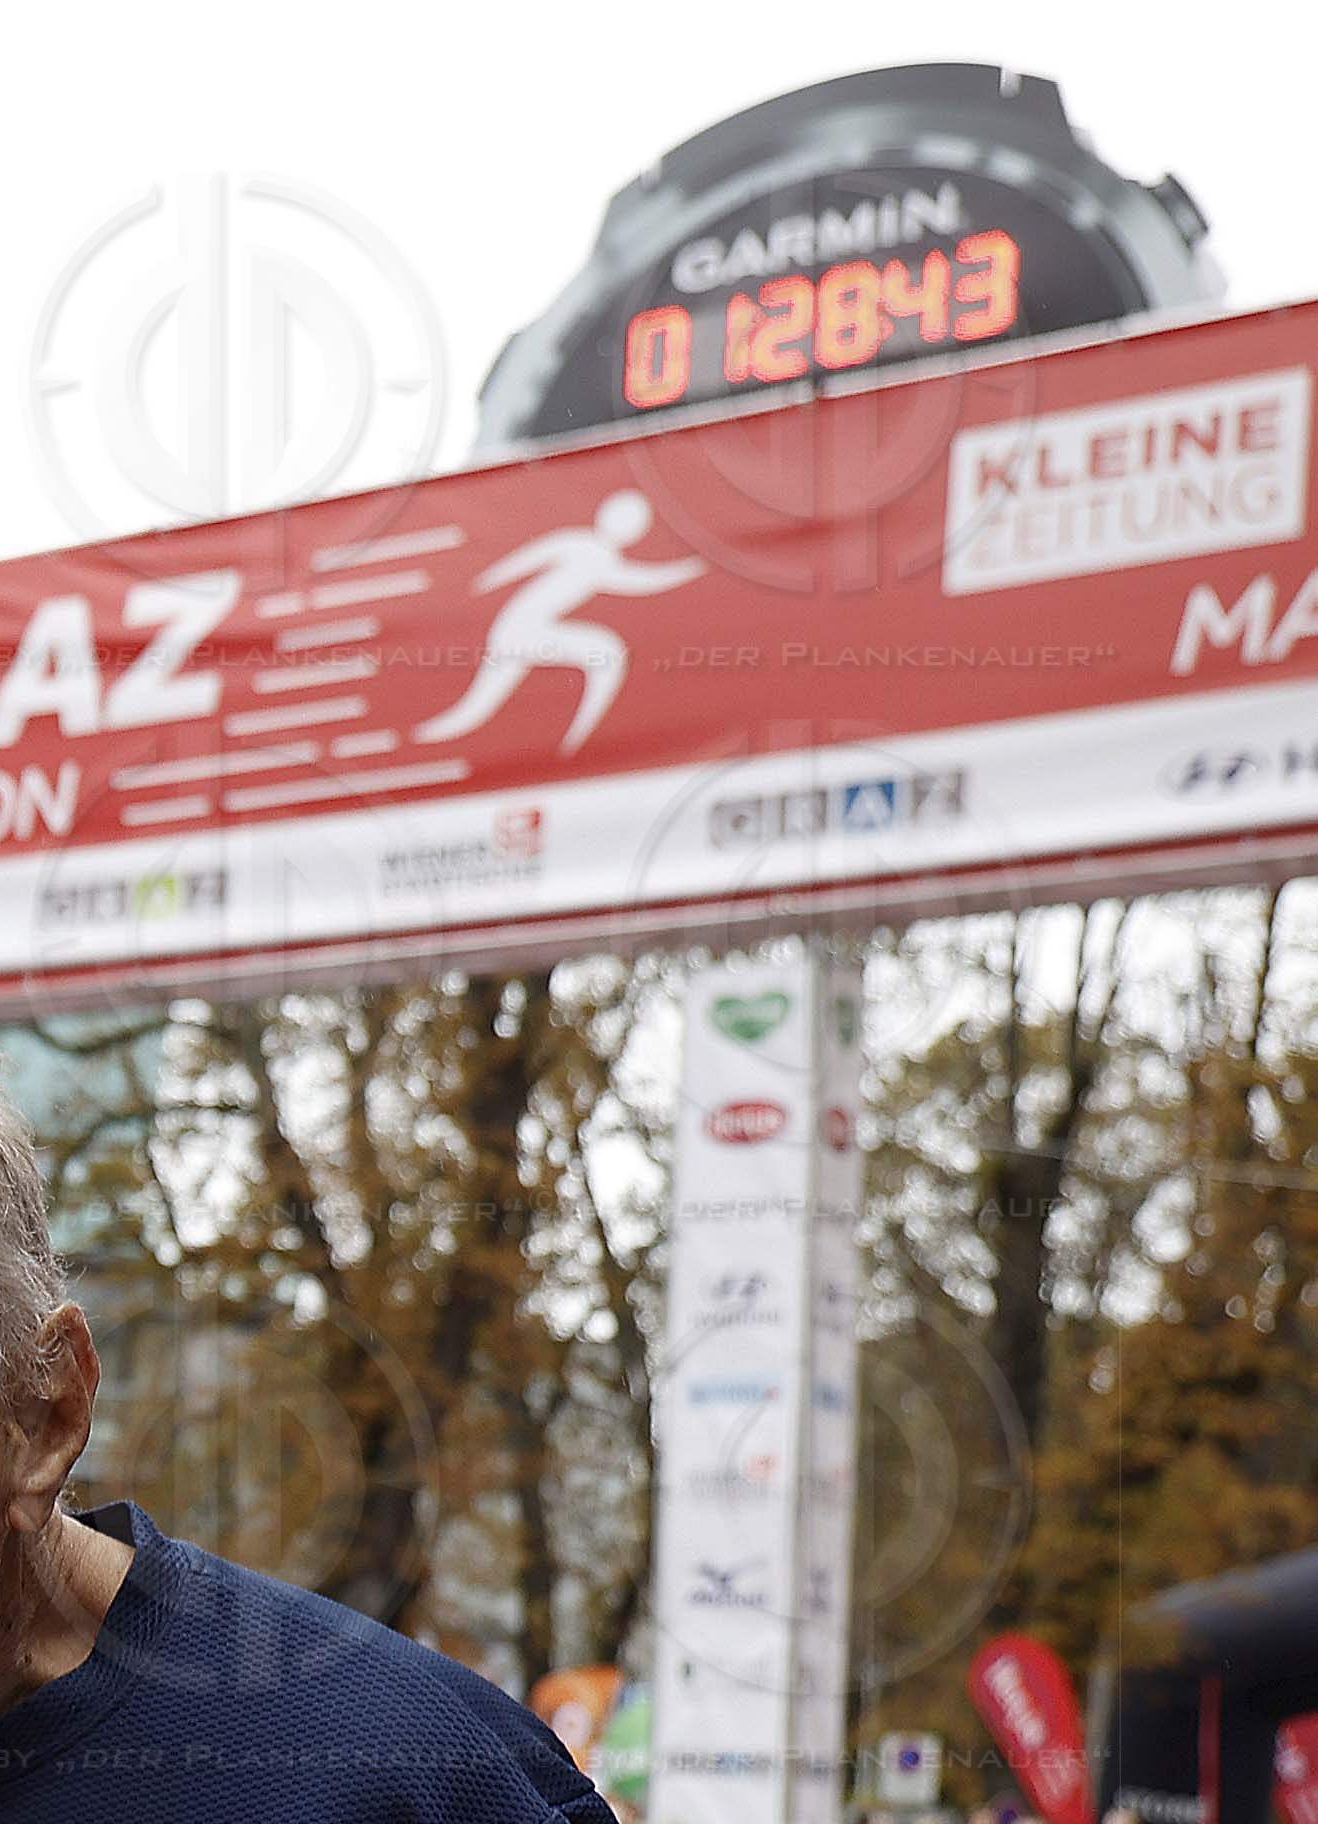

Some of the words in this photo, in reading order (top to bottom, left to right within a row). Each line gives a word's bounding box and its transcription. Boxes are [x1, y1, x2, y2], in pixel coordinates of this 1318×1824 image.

[670, 181, 962, 294] GARMIN
[976, 396, 1283, 500] KLEINE
[967, 468, 1285, 571] ZEITUNG
